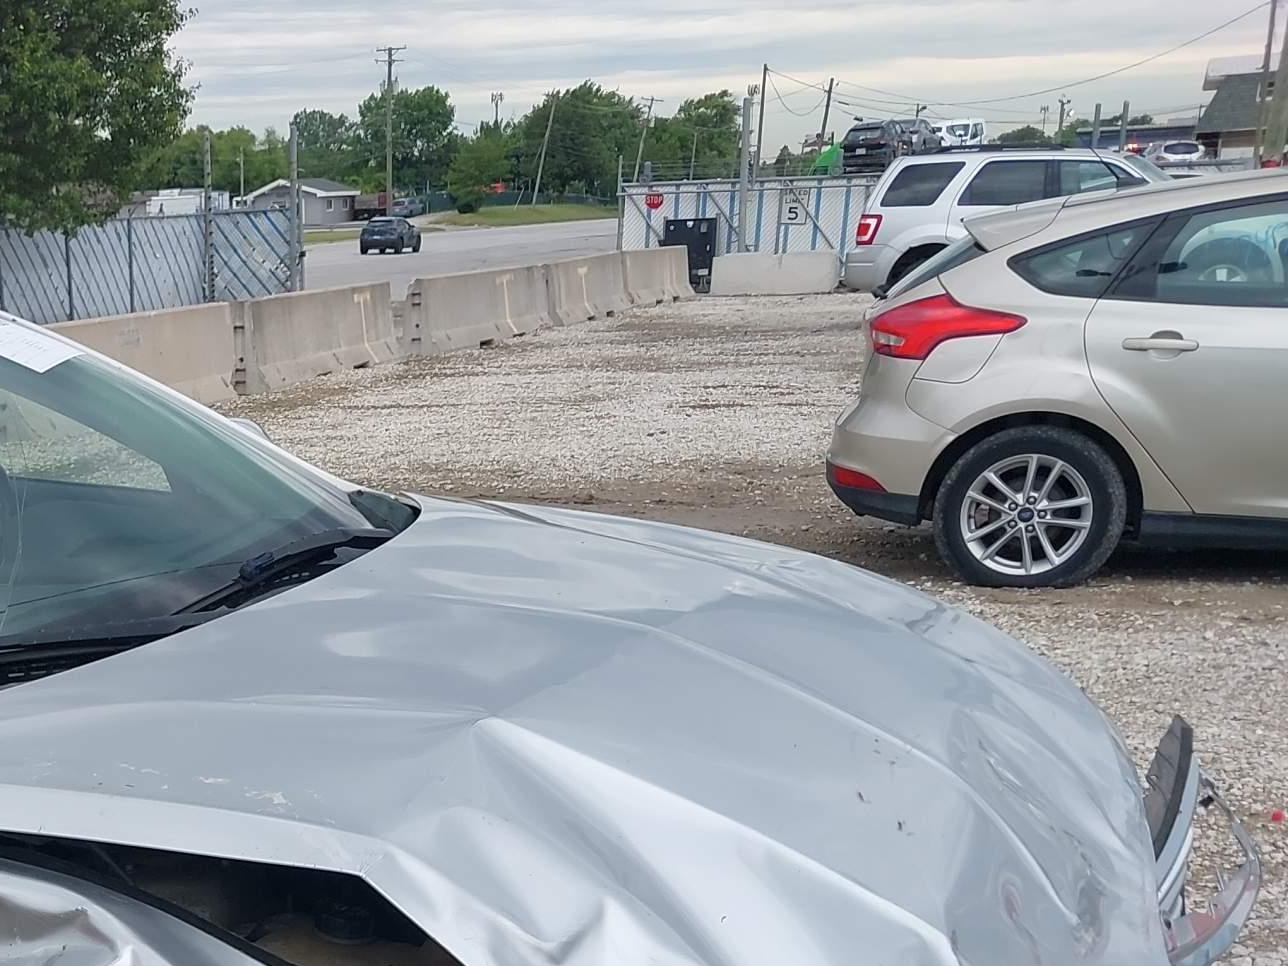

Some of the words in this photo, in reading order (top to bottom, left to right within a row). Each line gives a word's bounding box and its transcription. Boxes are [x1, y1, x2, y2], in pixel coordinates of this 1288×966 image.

[646, 195, 663, 204] STOP
[785, 197, 805, 205] LIMI
[787, 206, 799, 221] 5
